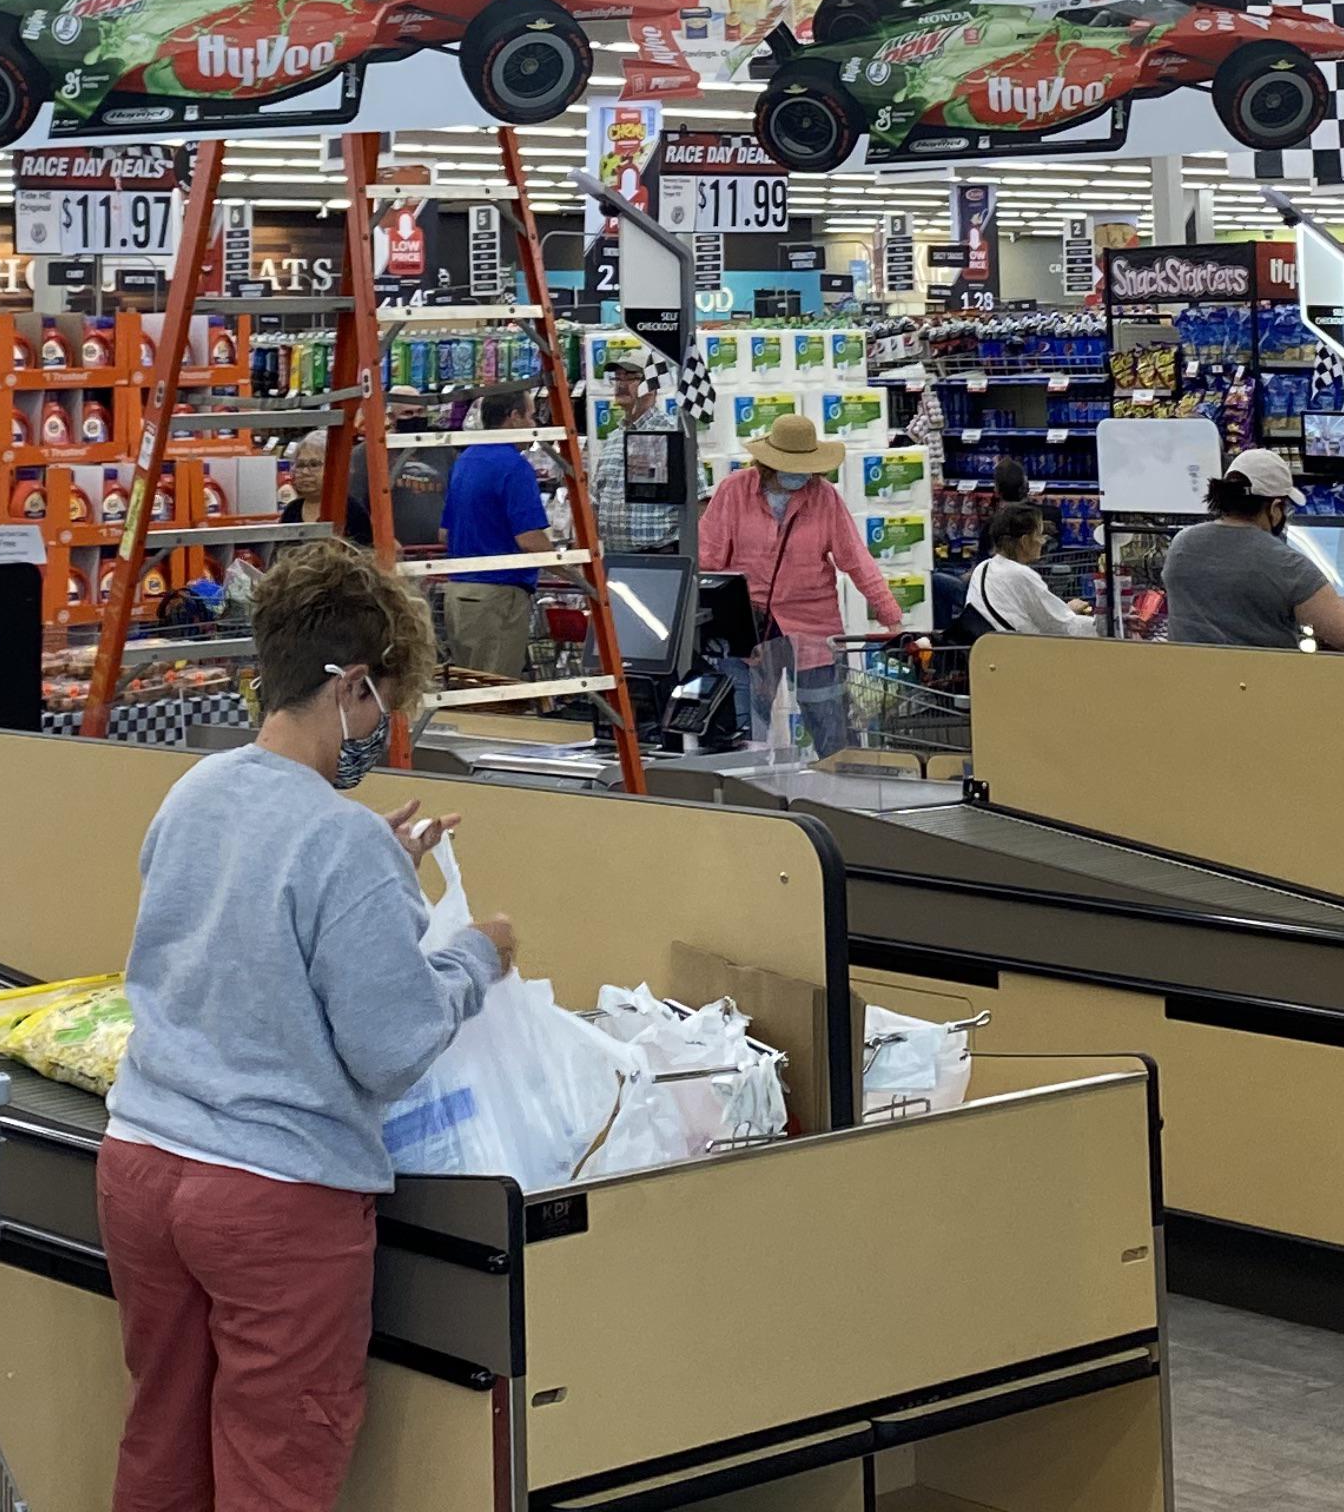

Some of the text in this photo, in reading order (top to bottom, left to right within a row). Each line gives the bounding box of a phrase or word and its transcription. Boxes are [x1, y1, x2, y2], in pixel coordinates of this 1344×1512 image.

[917, 10, 973, 24] HONDA
[197, 34, 336, 87] HyVee
[987, 76, 1105, 120] HyVee
[664, 145, 735, 164] RACE DAY
[20, 156, 166, 179] RACE DAY DEALS
[698, 178, 787, 227] $11.99
[62, 193, 172, 249] $11.97
[477, 211, 488, 226] 5
[893, 217, 903, 232] 3
[1073, 222, 1083, 236] 2
[391, 240, 421, 252] LOW
[969, 251, 986, 260] OW
[660, 312, 678, 321] SELF
[636, 321, 678, 331] CHECKOUT
